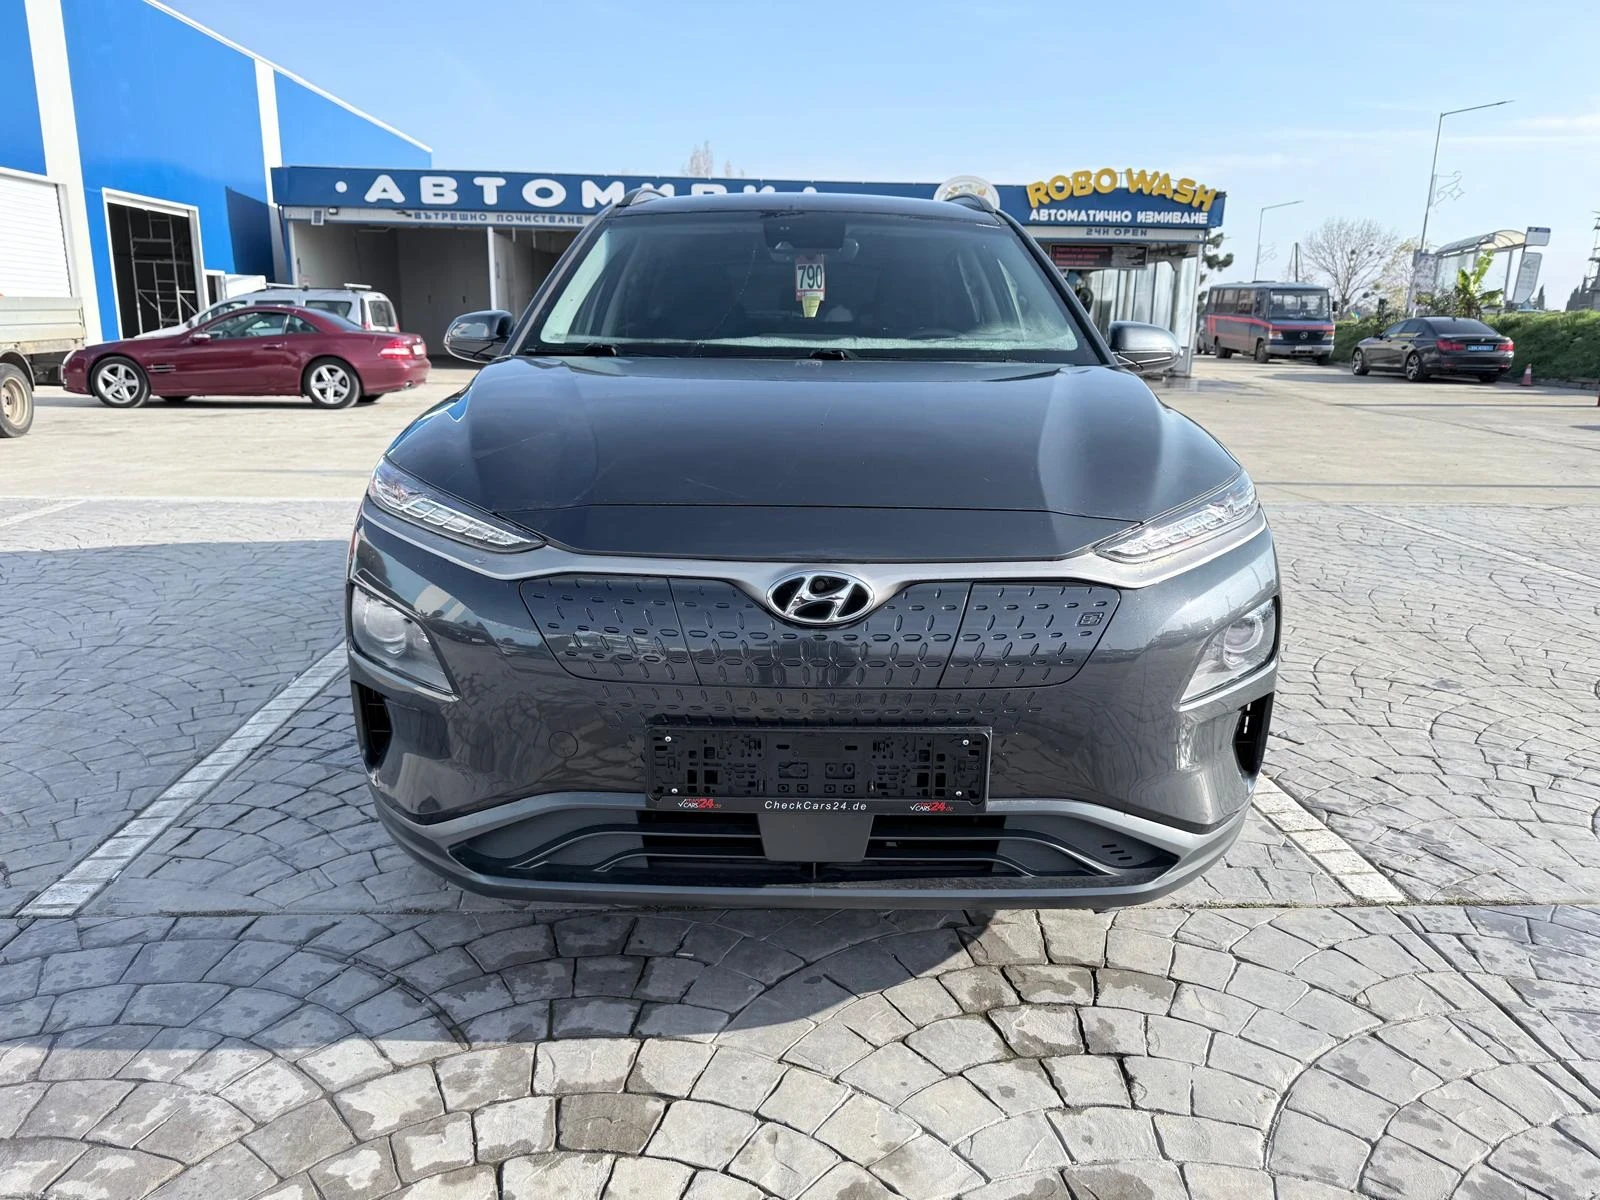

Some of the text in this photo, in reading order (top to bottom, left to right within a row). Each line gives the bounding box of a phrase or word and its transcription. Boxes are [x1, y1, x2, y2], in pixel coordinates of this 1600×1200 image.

[1026, 168, 1216, 211] ROBO WASH
[414, 212, 584, 224] ВЪТРЕШНО ПОЧИСТВАНЕ
[1029, 209, 1208, 225] АВТОМАТИЧНО ИЗМИВАНЕ
[1086, 227, 1147, 237] 24H OPEN
[797, 264, 823, 289] 790
[764, 800, 867, 811] CheckCars24.de
